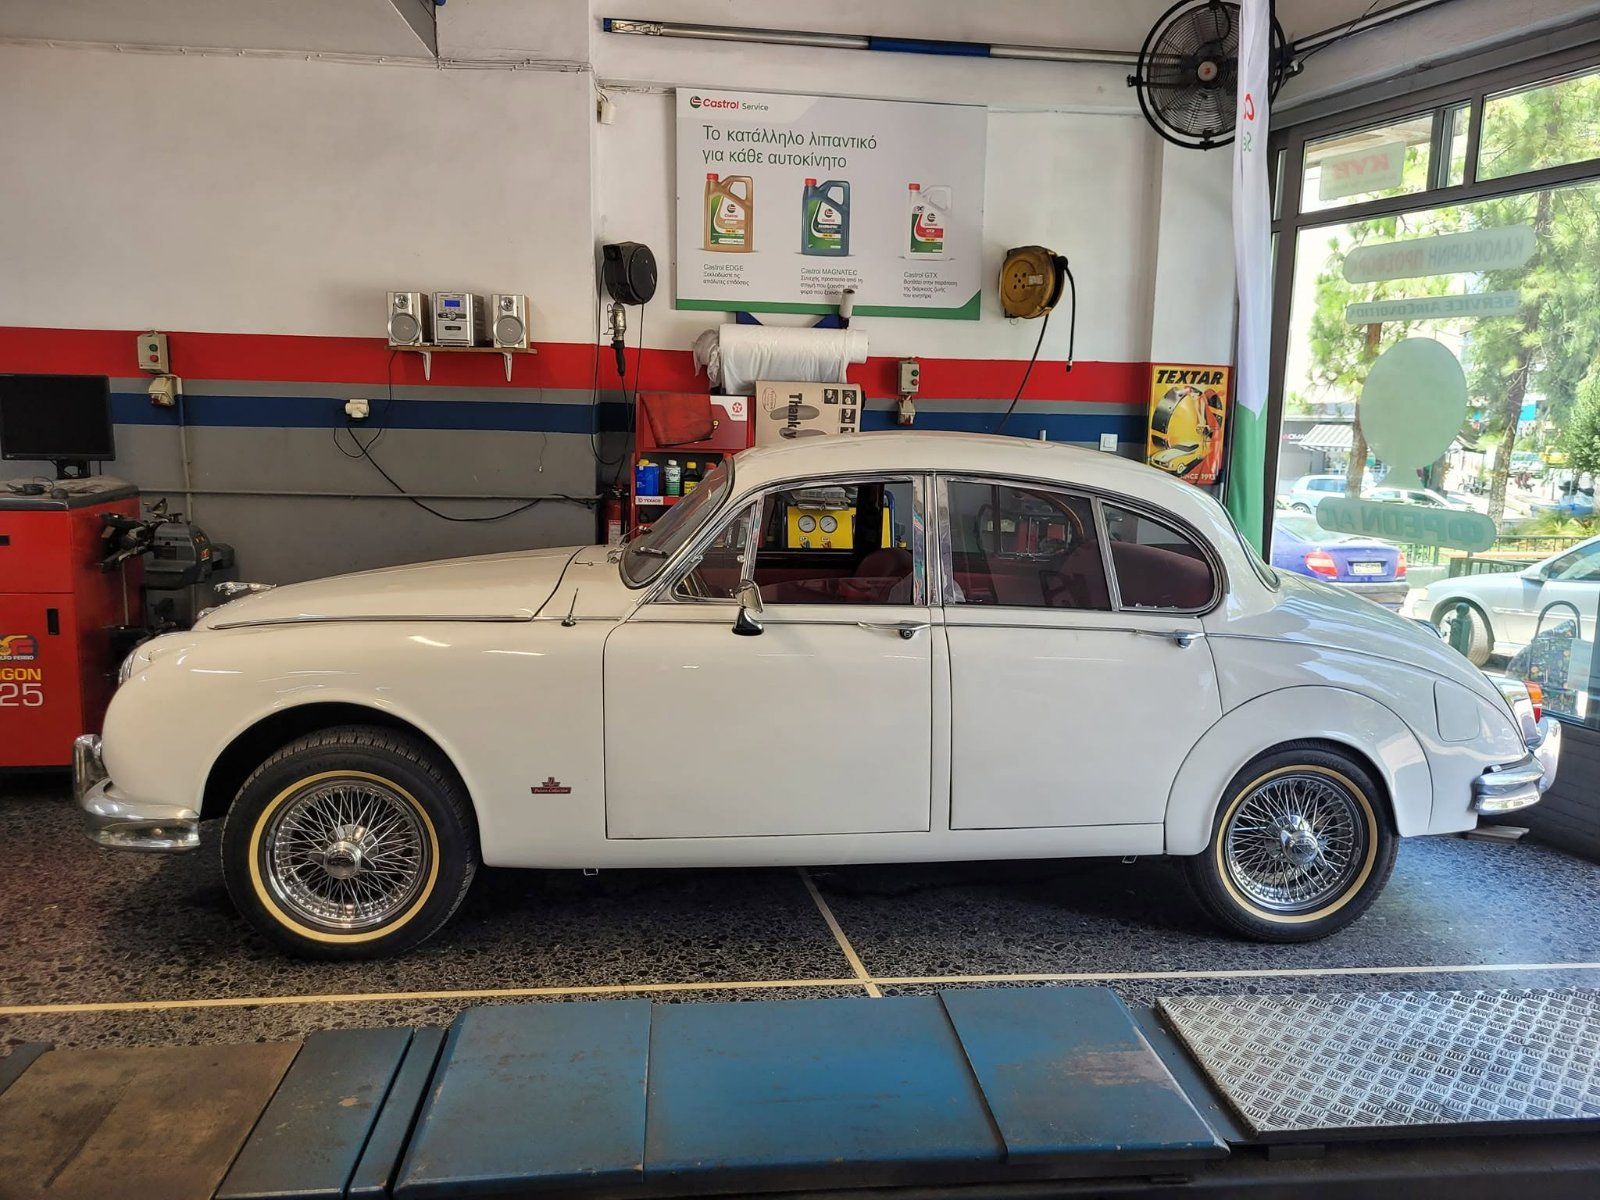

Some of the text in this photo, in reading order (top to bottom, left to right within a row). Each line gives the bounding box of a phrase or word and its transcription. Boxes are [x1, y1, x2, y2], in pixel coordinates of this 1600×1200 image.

[703, 98, 768, 112] Castrol Service
[702, 124, 877, 150] Το κατάλληλο λιπαντικό
[702, 148, 847, 171] για κάθε αυτοκίνητο
[1156, 370, 1224, 385] TEXTAR
[788, 393, 802, 428] Thank
[0, 668, 41, 680] GON
[0, 682, 44, 706] 25
